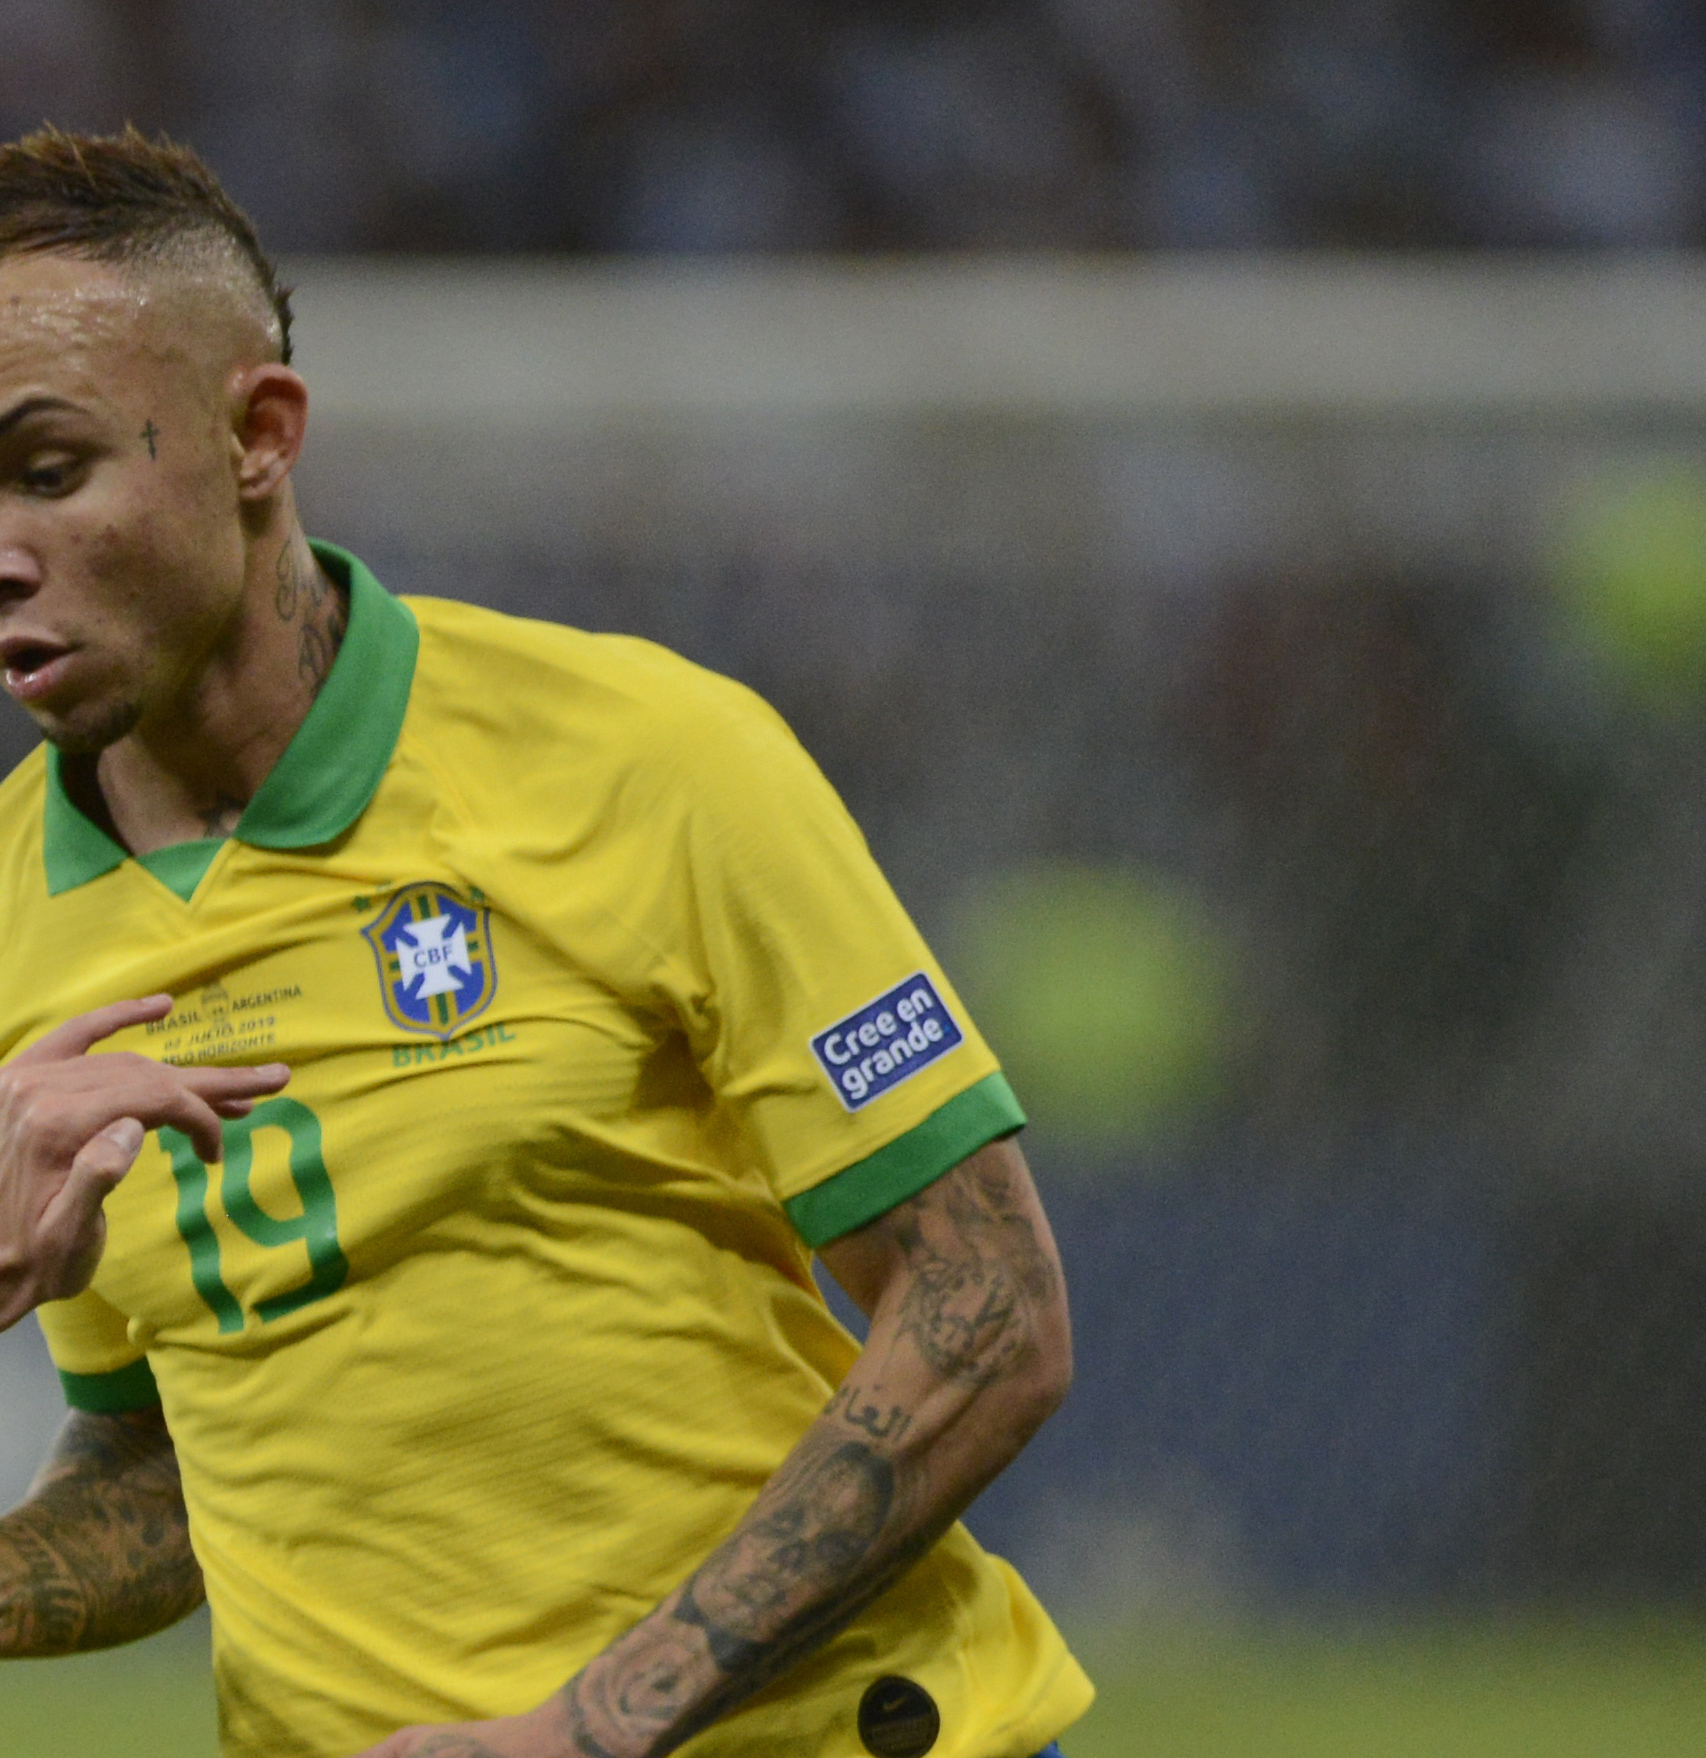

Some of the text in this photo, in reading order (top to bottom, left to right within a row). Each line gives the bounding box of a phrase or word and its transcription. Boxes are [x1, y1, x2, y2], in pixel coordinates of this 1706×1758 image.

[413, 945, 453, 968] CBF
[232, 984, 302, 1013] ARGENTINA
[824, 988, 933, 1065] Cree en
[392, 1024, 516, 1068] BRASIL
[842, 1020, 944, 1100] grande
[157, 1096, 349, 1335] 19
